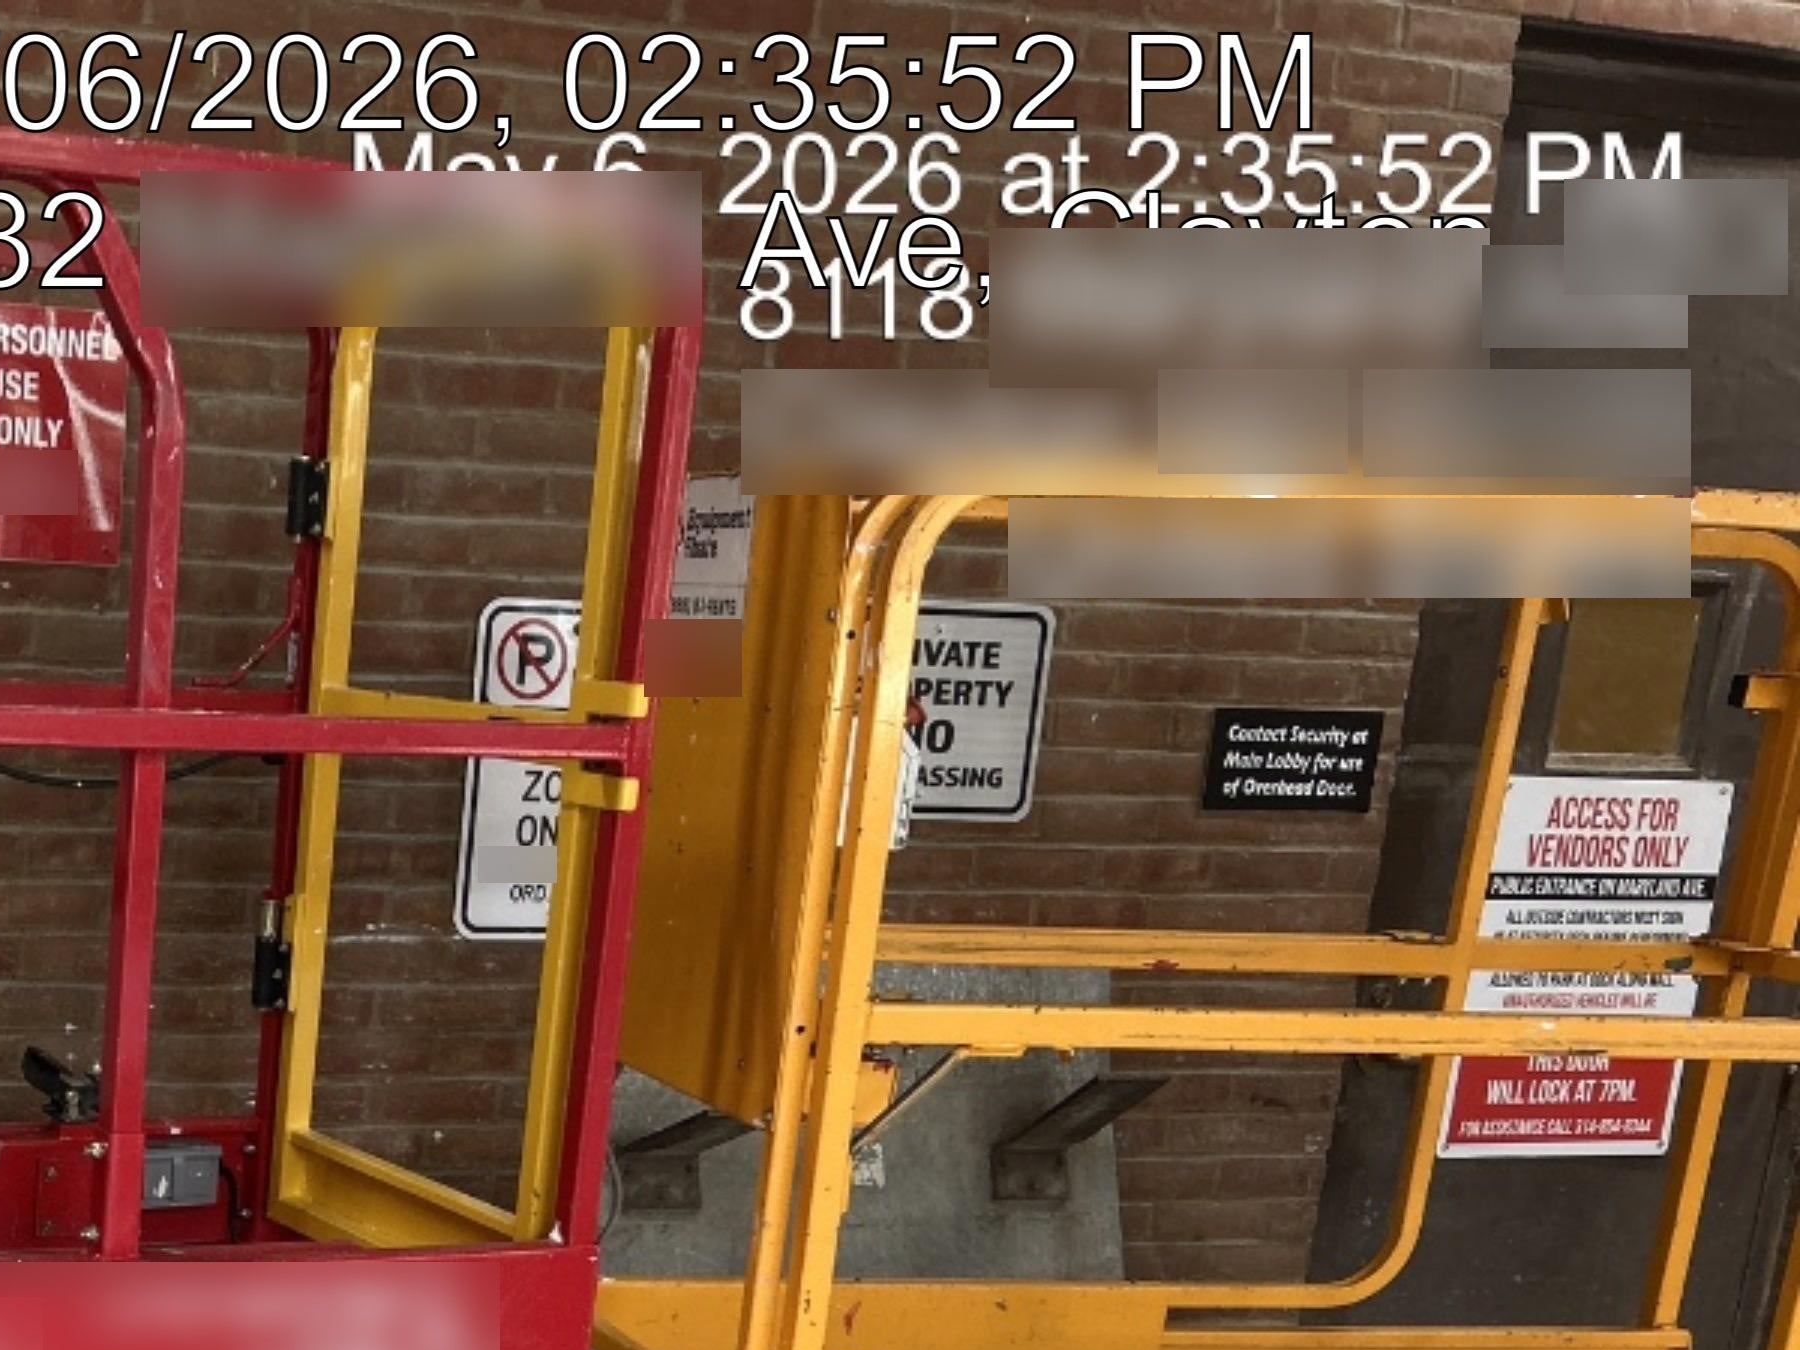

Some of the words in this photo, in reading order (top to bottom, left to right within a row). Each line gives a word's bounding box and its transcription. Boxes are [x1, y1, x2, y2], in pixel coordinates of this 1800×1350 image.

[912, 637, 1003, 669] IVATE
[909, 677, 1015, 709] PERTY
[1289, 725, 1350, 748] Security
[916, 765, 1004, 790] ASSING
[1265, 752, 1311, 774] Lobby
[1546, 795, 1633, 832] ACCESS
[1636, 798, 1681, 832] FOR
[1527, 834, 1630, 868] VENDORS
[1632, 836, 1691, 868] ONLY
[1486, 1079, 1526, 1105] WILL
[1528, 1080, 1572, 1104] LOCK
[1575, 1080, 1596, 1103] AT
